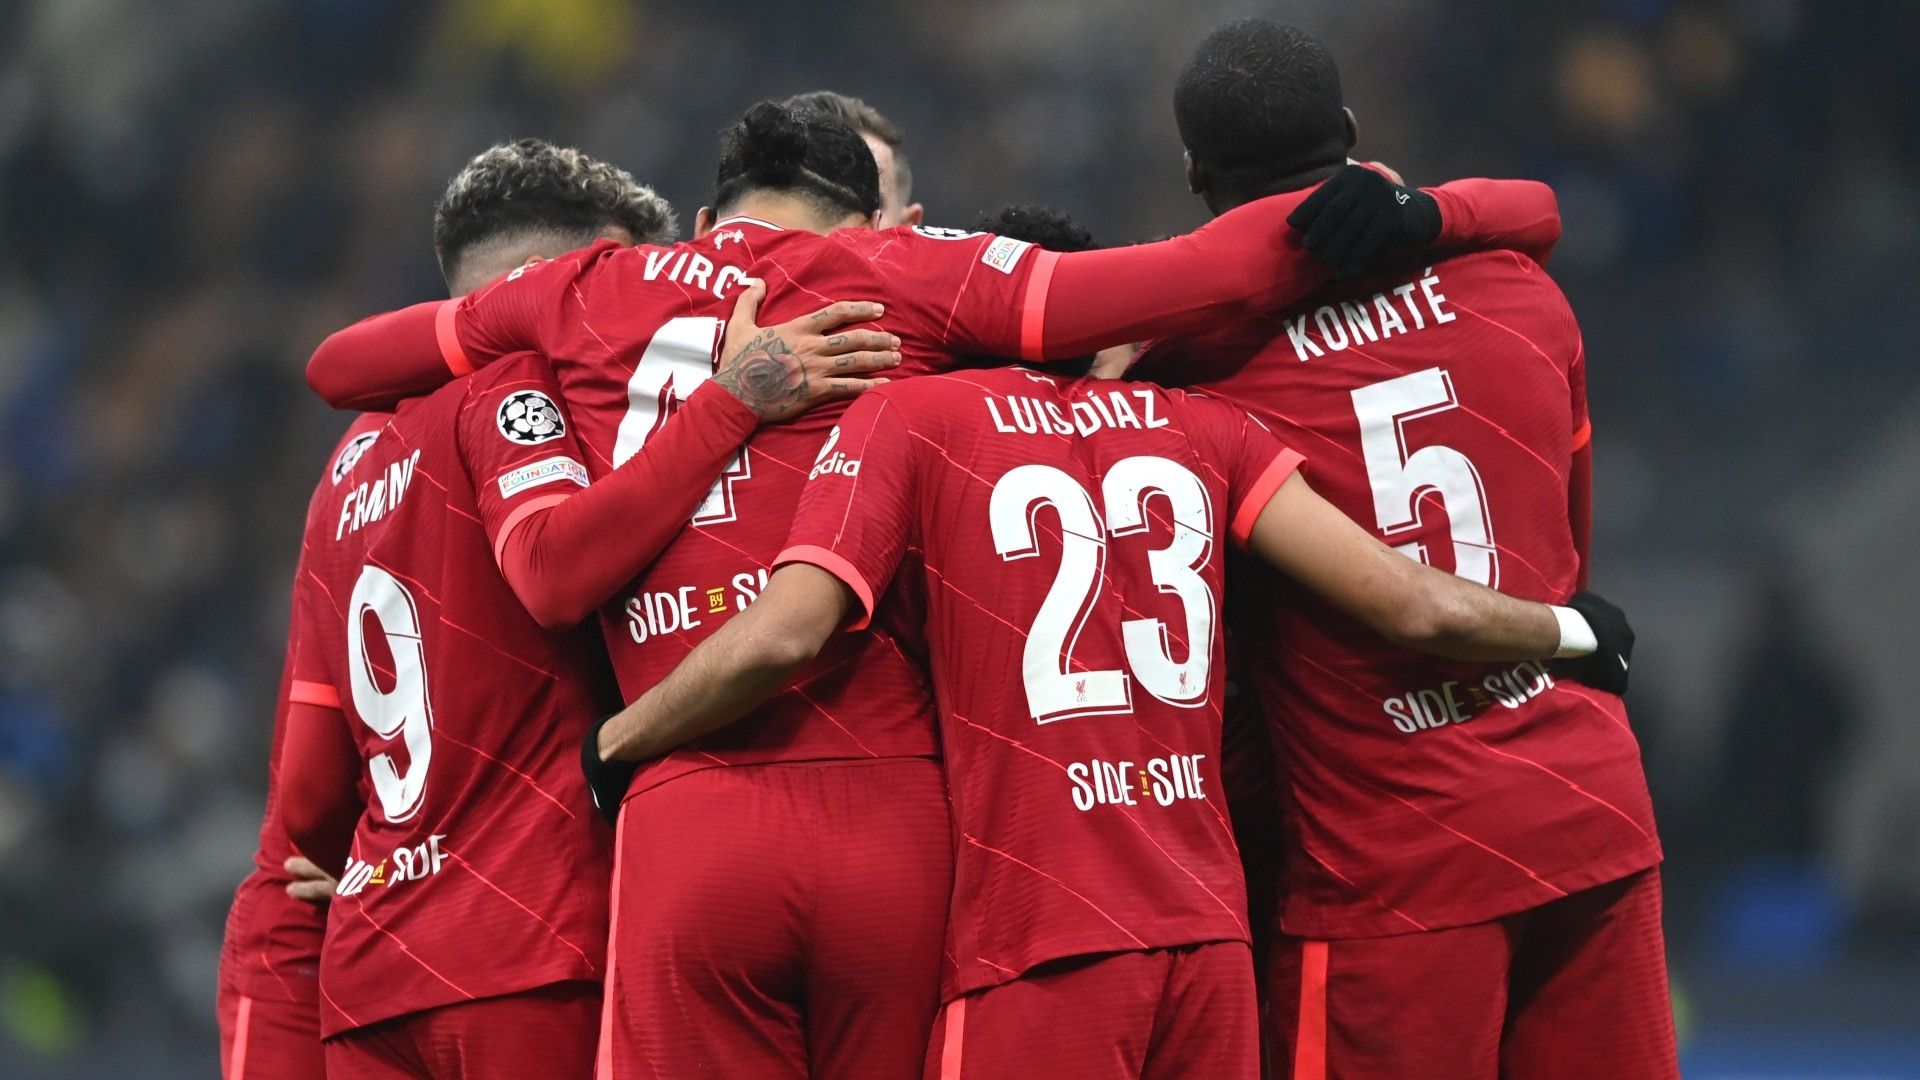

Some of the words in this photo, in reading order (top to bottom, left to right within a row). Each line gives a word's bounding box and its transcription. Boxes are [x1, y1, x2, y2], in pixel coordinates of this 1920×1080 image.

[1282, 267, 1456, 361] KONATÉ
[613, 317, 751, 526] 4
[984, 395, 1074, 435] LUIS
[1071, 390, 1169, 438] DÍAZ
[1351, 367, 1499, 590] 5
[625, 586, 701, 644] SIDE
[989, 456, 1215, 724] 23
[348, 565, 433, 823] 9
[1383, 681, 1471, 733] SIDE
[1067, 759, 1137, 811] SIDE
[1148, 754, 1206, 806] SIDE
